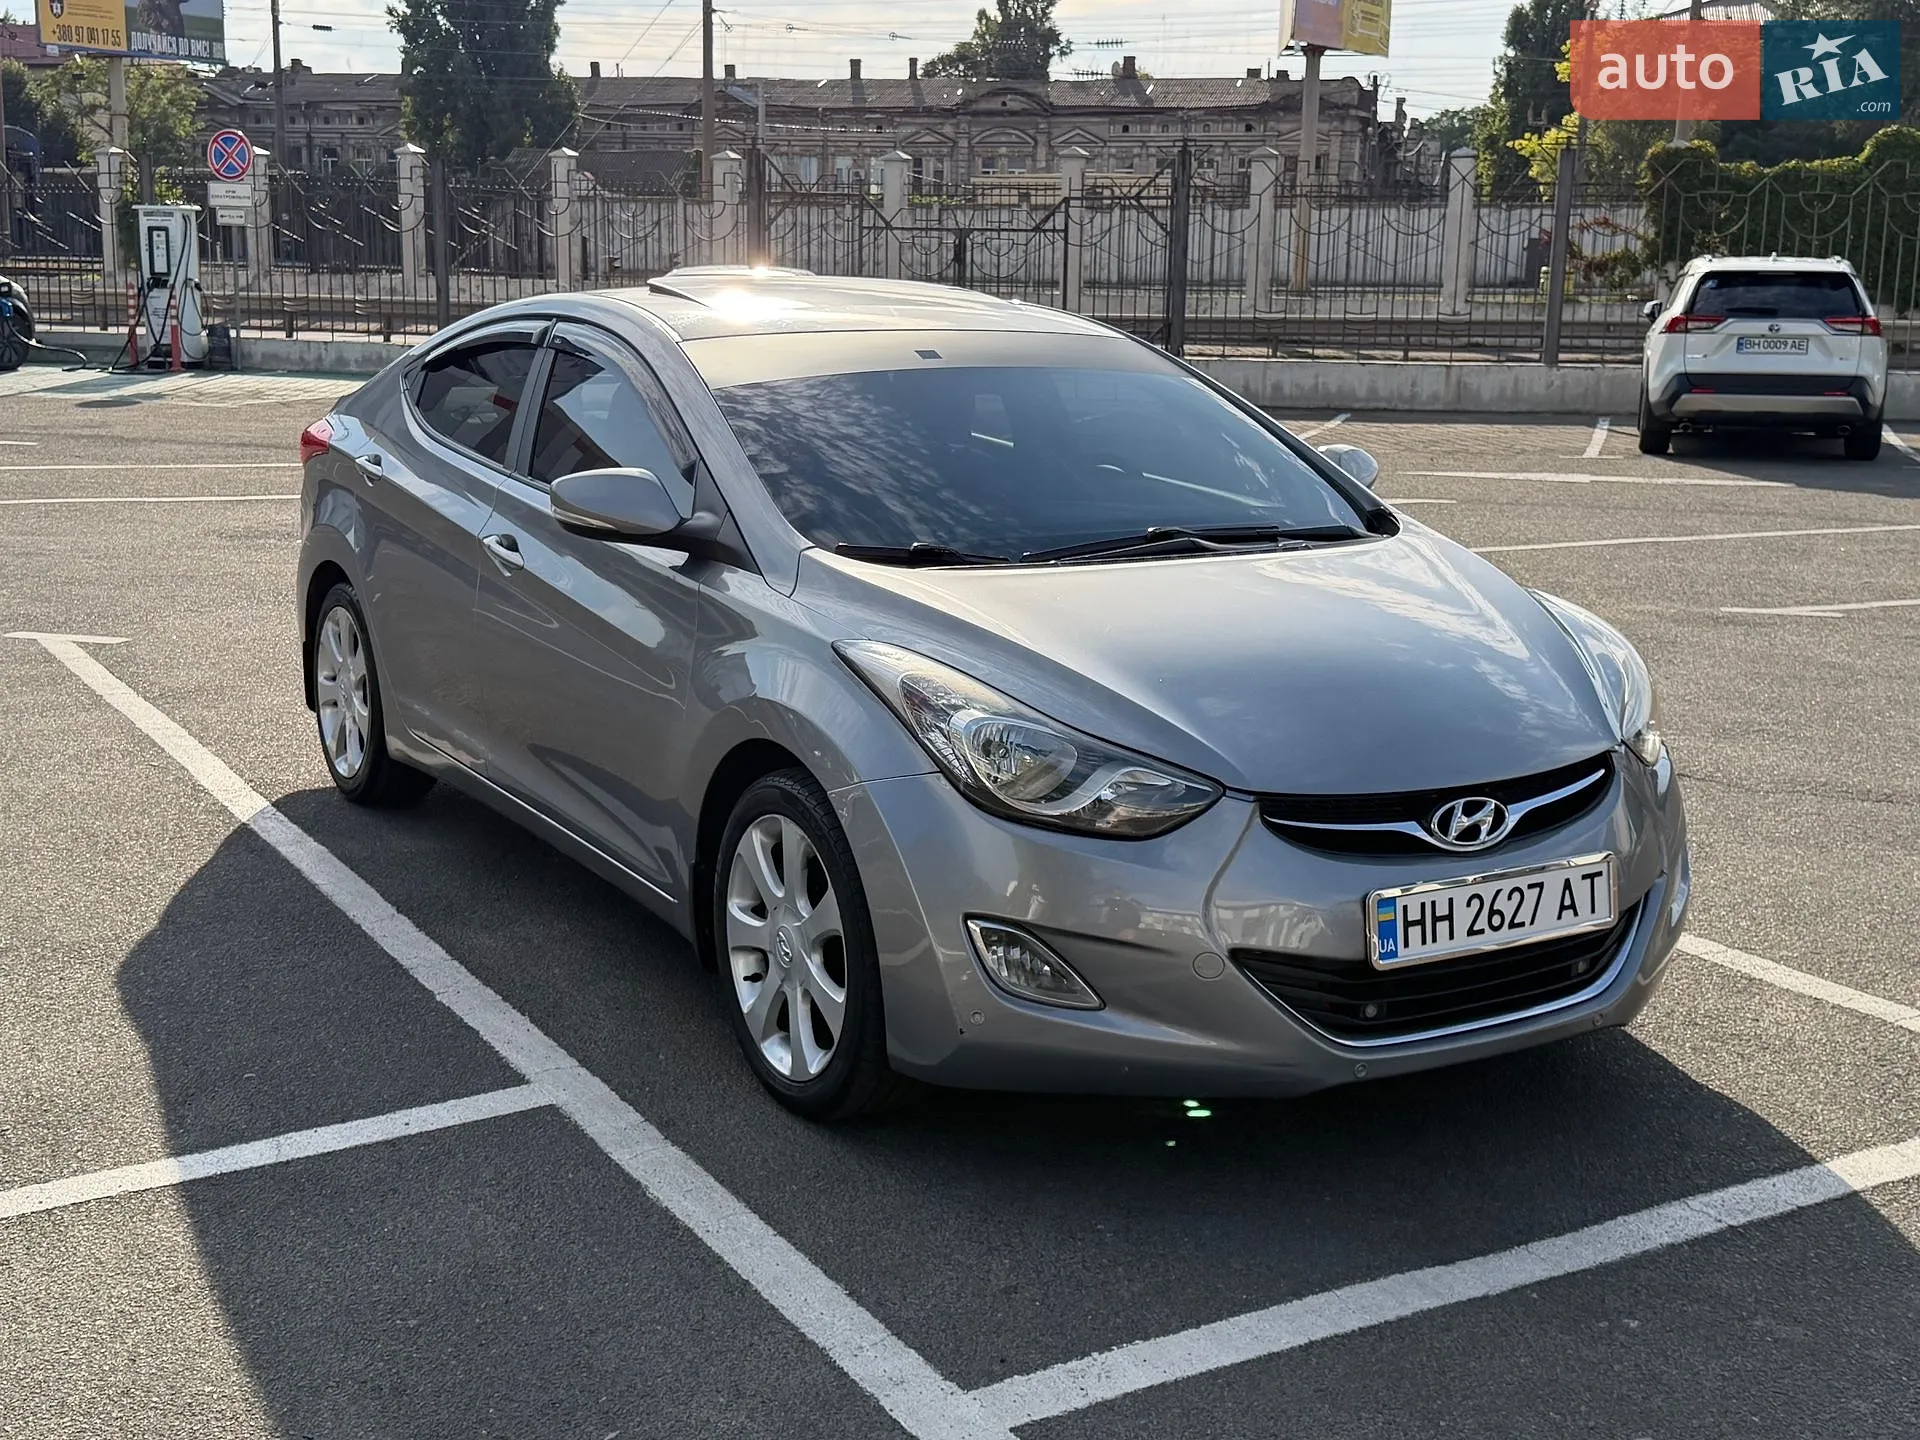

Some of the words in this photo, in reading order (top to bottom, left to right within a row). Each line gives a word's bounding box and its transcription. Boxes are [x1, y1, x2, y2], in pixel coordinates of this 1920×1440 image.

[52, 24, 73, 42] +380
[75, 25, 84, 43] 97
[86, 26, 99, 45] 041
[101, 28, 109, 46] 17
[111, 29, 121, 47] 55
[131, 31, 177, 54] ДОЛУЧАЙСЯ
[178, 37, 189, 57] ДО
[190, 39, 210, 58] ВМС!
[1744, 339, 1761, 350] BH
[1762, 339, 1789, 351] 0009
[1790, 340, 1805, 351] AE
[1402, 897, 1455, 949] HH
[1466, 881, 1545, 937] 2627
[1556, 870, 1603, 920] AT
[1379, 940, 1396, 953] UA
